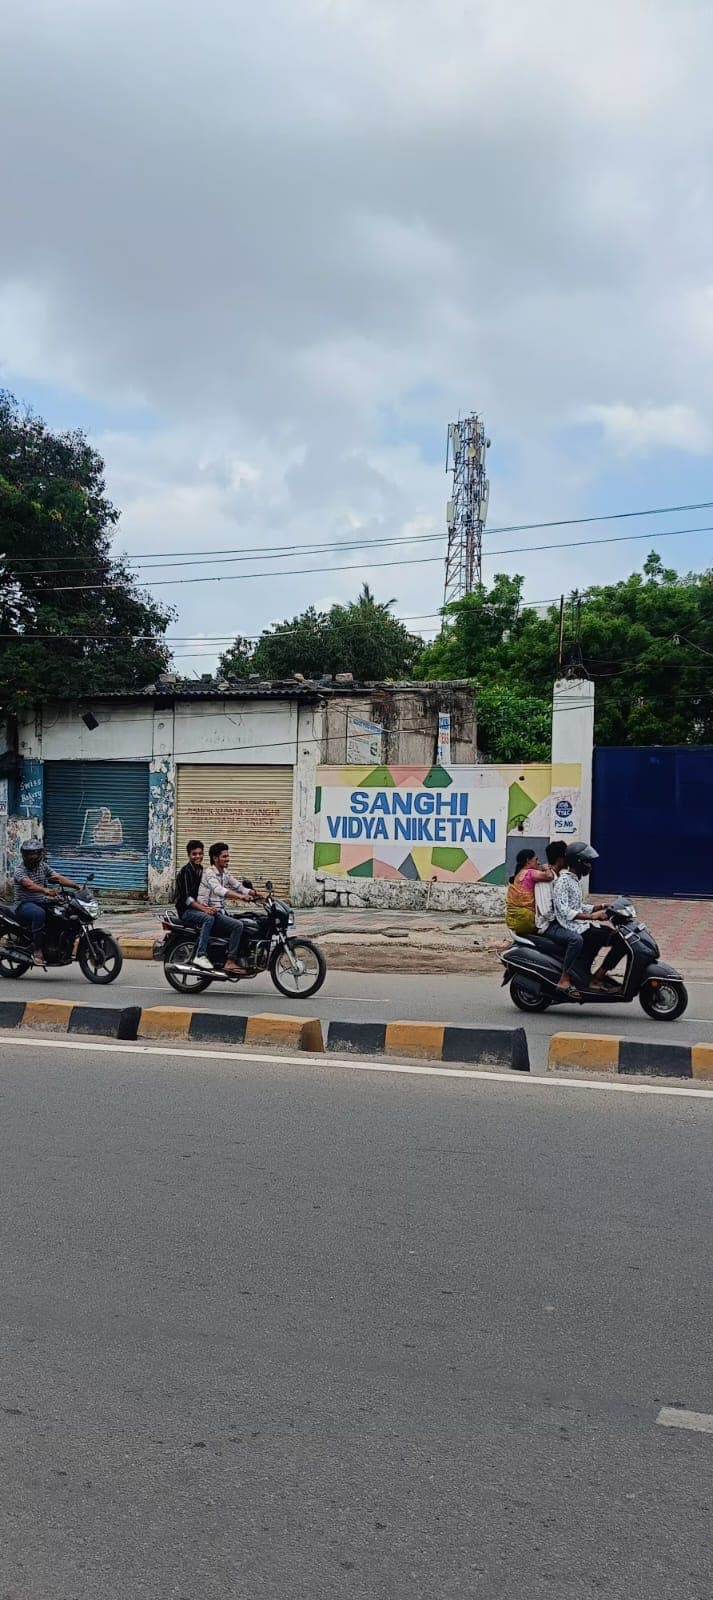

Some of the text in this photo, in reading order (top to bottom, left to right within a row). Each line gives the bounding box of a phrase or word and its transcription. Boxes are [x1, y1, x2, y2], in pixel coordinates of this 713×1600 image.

[350, 791, 469, 816] SANGHI
[327, 816, 496, 843] VIDYA NIKETAN
